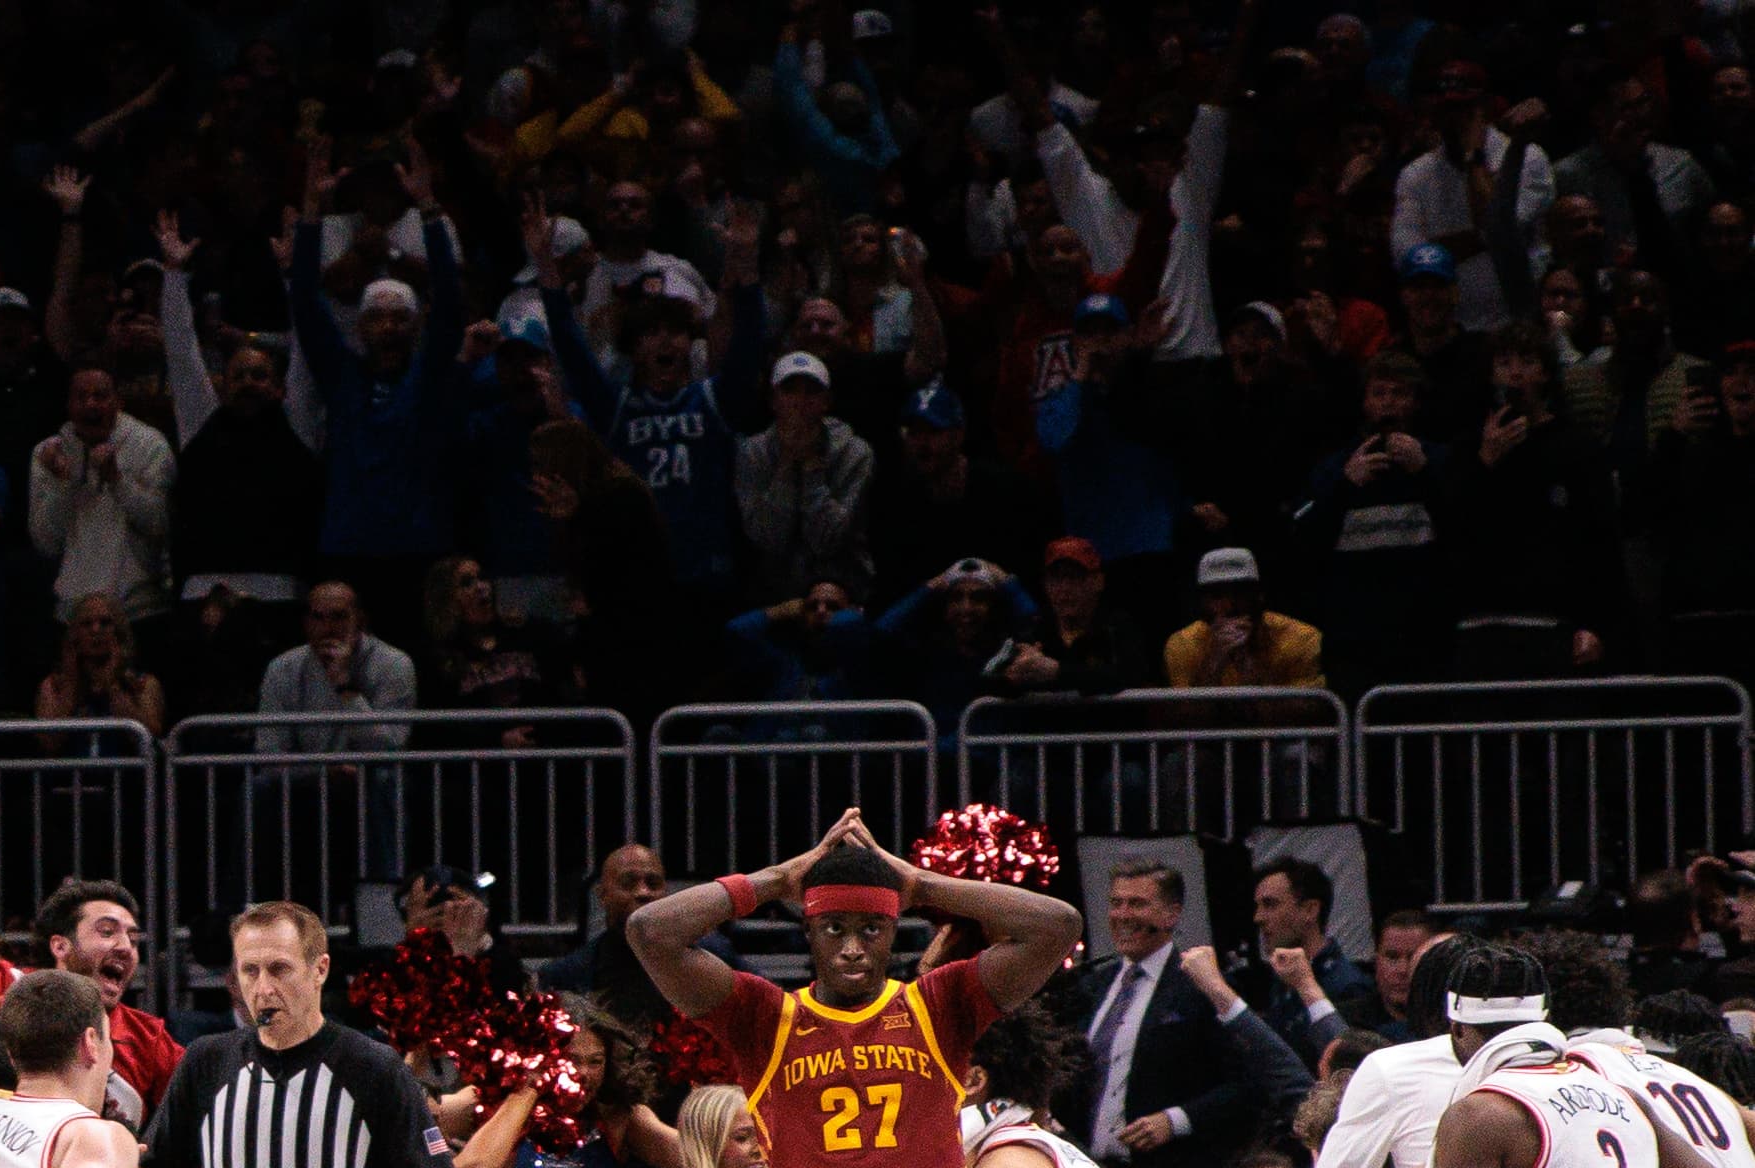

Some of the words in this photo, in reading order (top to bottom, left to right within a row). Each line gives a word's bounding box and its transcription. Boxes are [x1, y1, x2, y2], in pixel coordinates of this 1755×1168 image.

[627, 412, 705, 446] BYU
[646, 442, 691, 488] 24
[784, 1047, 847, 1092] IOWA
[852, 1045, 933, 1080] STATE
[820, 1083, 902, 1152] 27
[1646, 1082, 1731, 1150] 10
